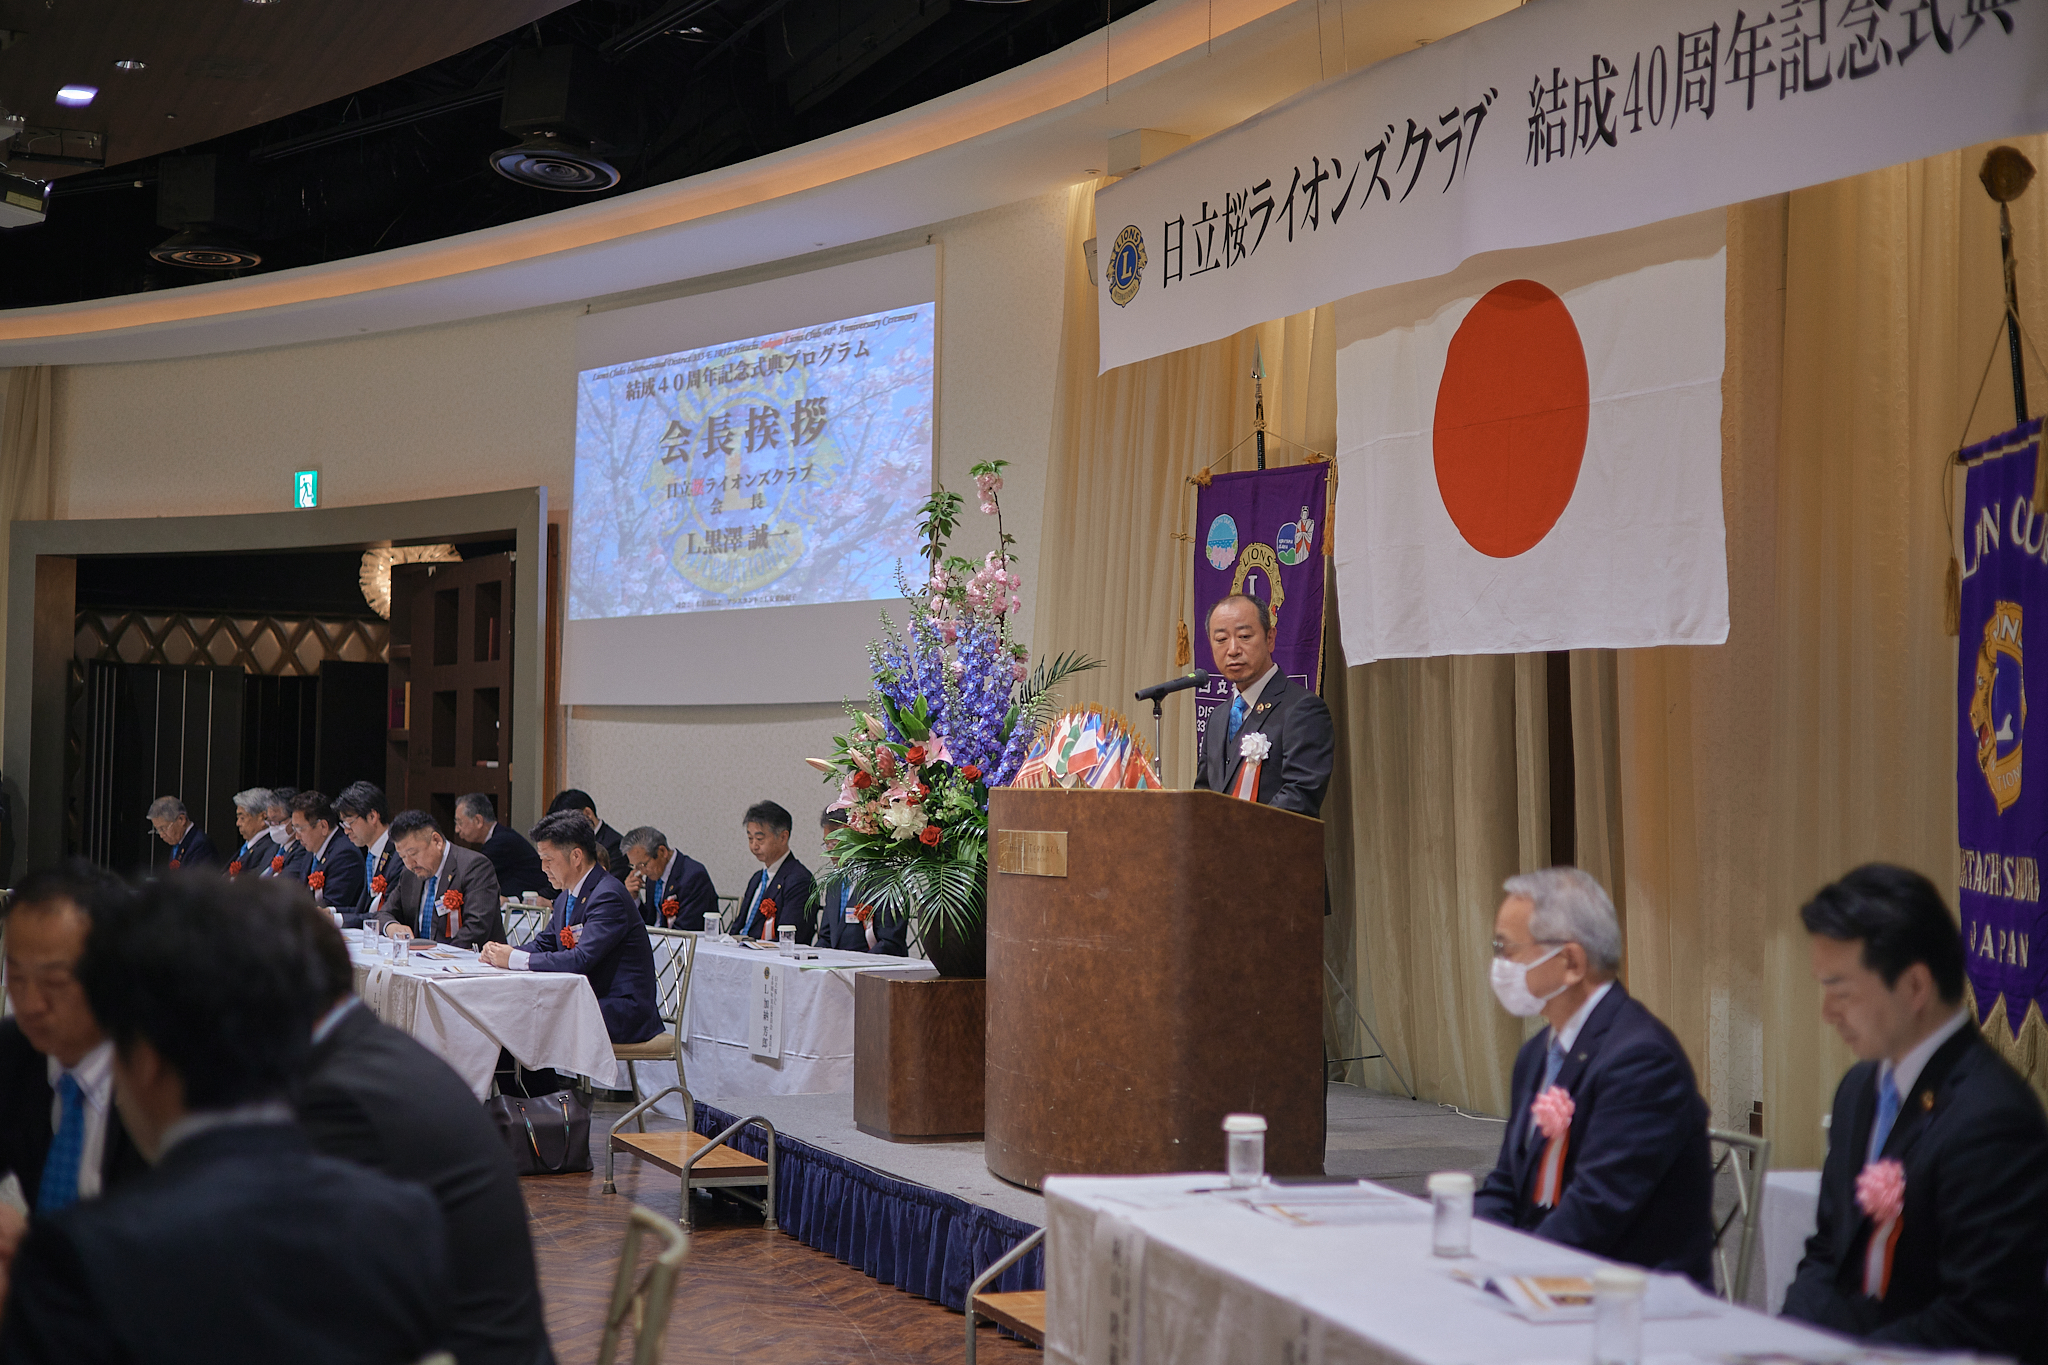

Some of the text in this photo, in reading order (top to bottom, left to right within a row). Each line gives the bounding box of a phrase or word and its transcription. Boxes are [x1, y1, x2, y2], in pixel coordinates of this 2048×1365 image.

[1163, 87, 1498, 289] 日立桜ライオンズクラブ
[1116, 228, 1140, 248] LIONS
[837, 318, 882, 336] Anniversary
[882, 312, 918, 326] Ceremony
[626, 339, 870, 401] 結成40周年記念式典プログラム
[659, 396, 829, 466] 会長挨拶
[1242, 548, 1274, 568] LIONS
[1970, 921, 2028, 968] JAPAN
